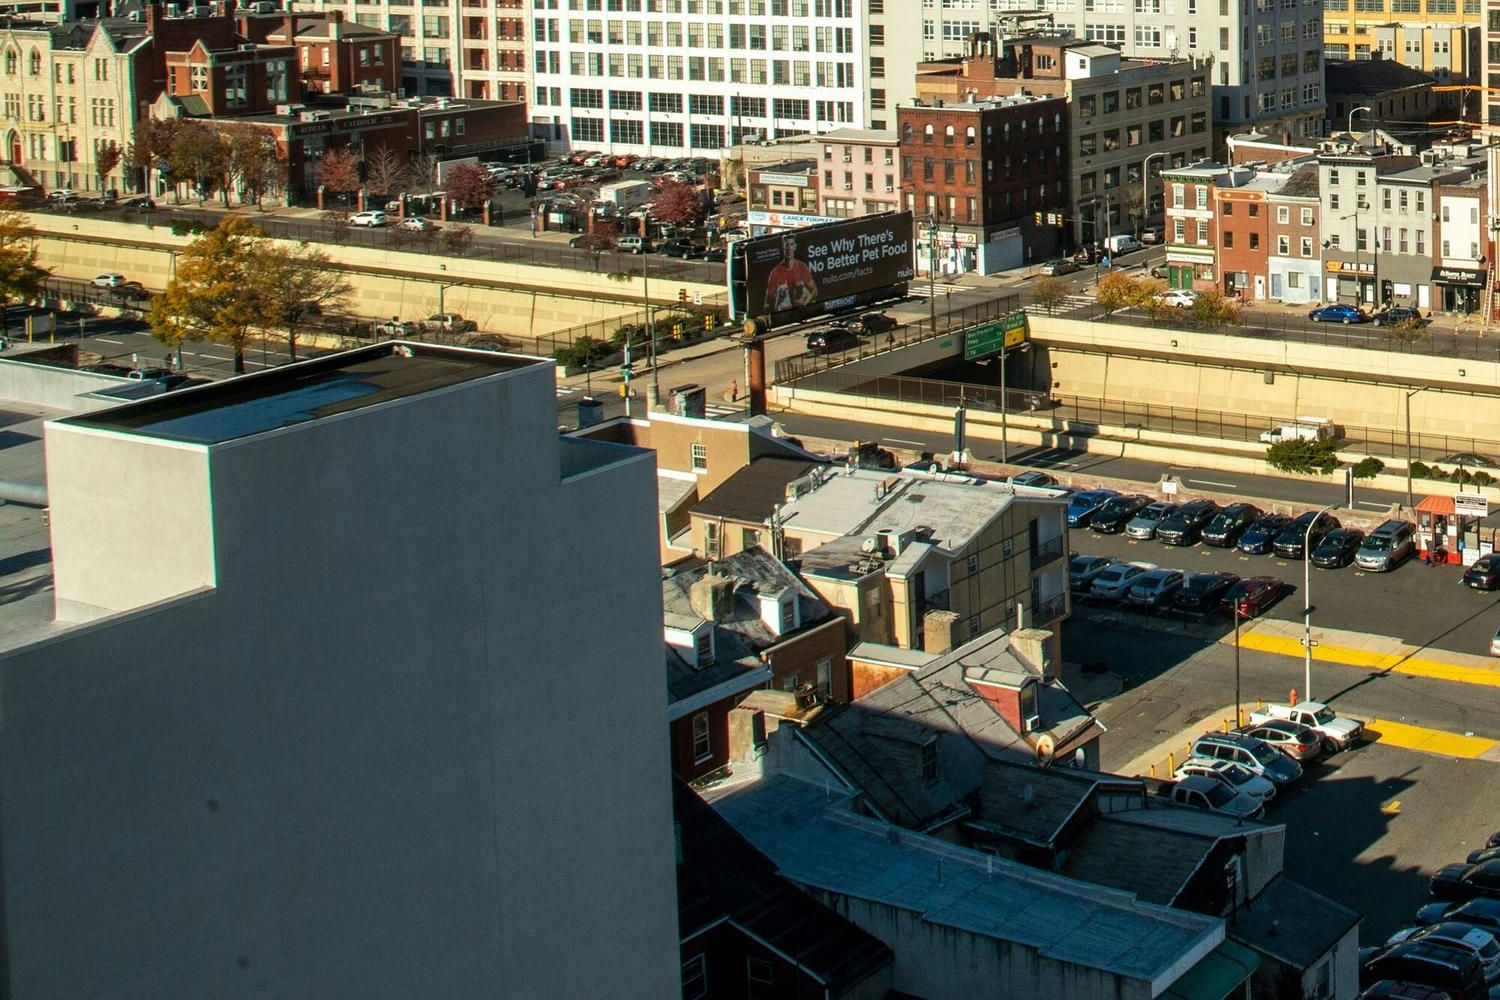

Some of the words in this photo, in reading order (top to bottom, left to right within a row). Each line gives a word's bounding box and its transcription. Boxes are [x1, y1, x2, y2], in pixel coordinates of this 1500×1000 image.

[807, 245, 828, 258] See
[830, 239, 855, 253] Why
[857, 229, 894, 247] There's
[808, 260, 825, 273] No
[827, 253, 860, 270] Better
[862, 249, 880, 262] Pet
[882, 240, 908, 258] Food
[822, 266, 874, 285] nulo.com/facts
[897, 267, 913, 278] nulo
